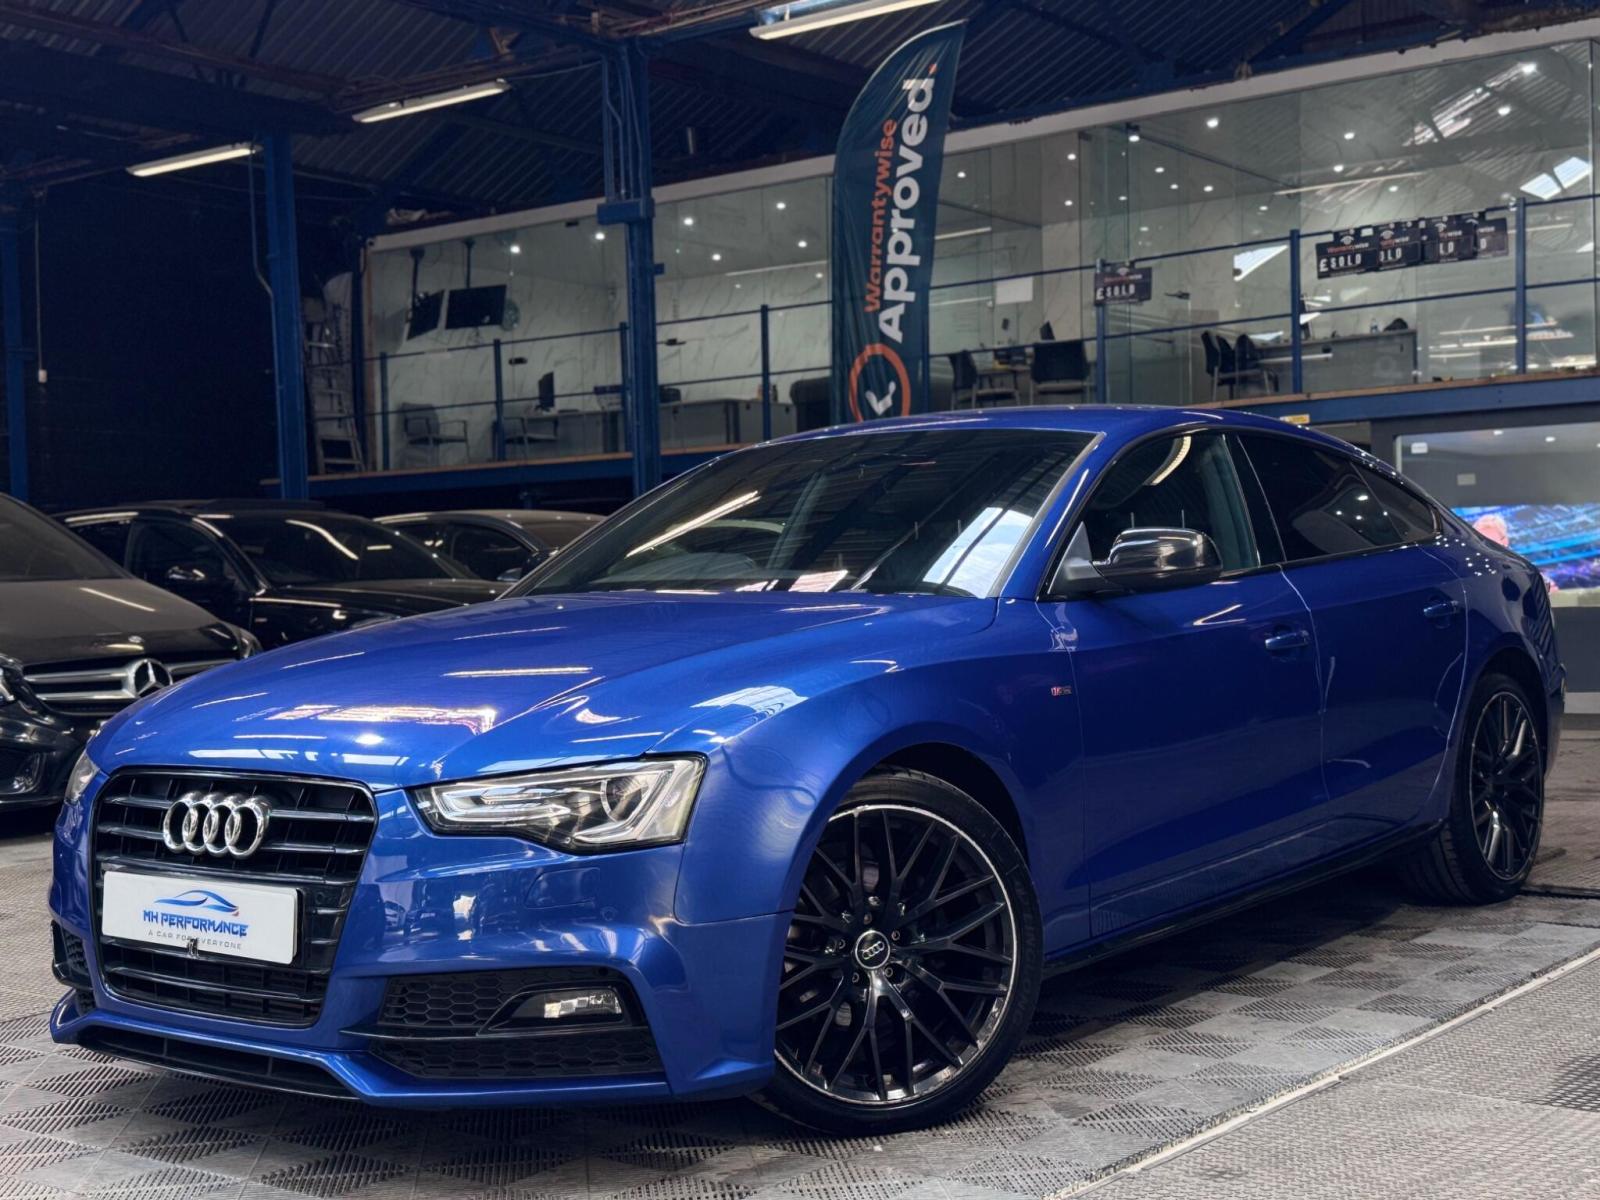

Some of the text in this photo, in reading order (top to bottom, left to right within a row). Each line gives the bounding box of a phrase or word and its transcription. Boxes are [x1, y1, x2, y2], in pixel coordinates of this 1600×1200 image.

[864, 118, 898, 313] Warrantywise
[878, 63, 938, 344] Approved.
[143, 909, 249, 938] MH PERFORMANCE
